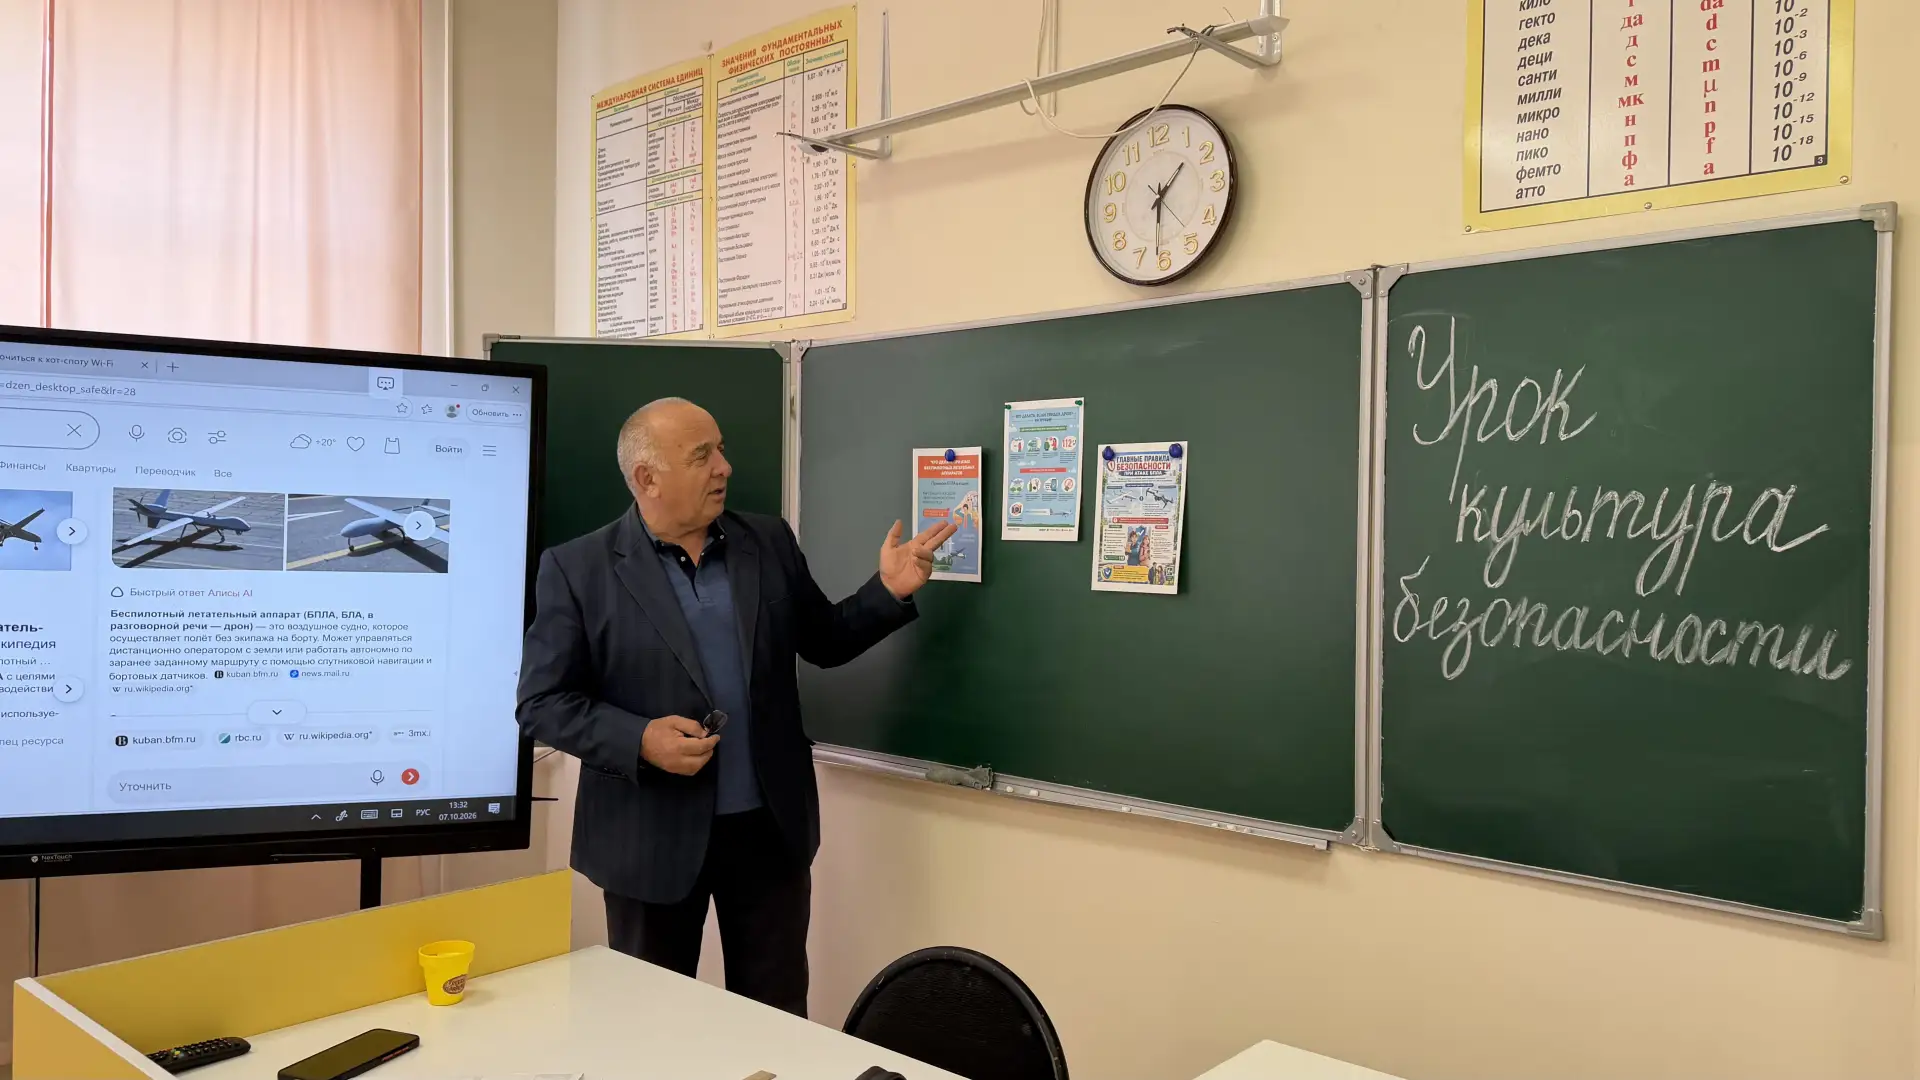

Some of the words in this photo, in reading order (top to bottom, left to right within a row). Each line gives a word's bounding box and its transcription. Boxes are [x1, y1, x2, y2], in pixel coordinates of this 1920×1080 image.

[1519, 12, 1555, 30] гекто
[1518, 32, 1551, 52] дека
[1620, 14, 1643, 31] да
[721, 48, 757, 68] ЗНАЧЕНИЯ
[761, 20, 843, 53] ФУНДАМЕНТАЛЬНЫХ
[1517, 51, 1553, 70] деци
[1626, 35, 1639, 50] д
[1706, 13, 1718, 31] d
[728, 53, 775, 75] ФИЗИЧЕСКИХ
[780, 33, 834, 58] ПОСТОЯННЫХ
[1517, 87, 1562, 105] милли
[1702, 58, 1720, 73] m
[1518, 69, 1557, 86] санти
[596, 86, 647, 110] МЕЖДУНАРОДНАЯ
[648, 77, 676, 92] СИСТЕМА
[676, 68, 703, 83] ЕДИНИЦ
[1517, 106, 1560, 124] микро
[1618, 93, 1644, 108] мк
[1516, 127, 1549, 143] нано
[1704, 100, 1716, 113] n
[1147, 123, 1170, 148] 12
[1182, 126, 1190, 148] 1
[1516, 146, 1548, 161] пико
[1704, 121, 1716, 138] p
[1122, 141, 1141, 166] 11
[1199, 141, 1215, 165] 2
[1516, 163, 1561, 183] фемто
[1622, 150, 1638, 170] ф
[1706, 137, 1716, 154] f
[1817, 156, 1824, 164] 3
[1105, 171, 1126, 195] 10
[1210, 170, 1225, 192] 3
[1515, 185, 1545, 199] атто
[1103, 203, 1117, 223] 9
[1202, 204, 1216, 226] 4
[1112, 230, 1127, 251] 8
[1183, 232, 1199, 255] 5
[1133, 246, 1147, 269] 7
[1157, 251, 1171, 271] 6
[46, 357, 89, 367] хот-споту
[91, 359, 114, 367] Wi-Fi
[472, 408, 509, 418] Обновить
[1408, 316, 1598, 505] Урок
[435, 444, 463, 454] Войти
[0, 461, 46, 471] Финансы
[66, 463, 116, 474] Квартиры
[135, 466, 196, 478] Переводчик
[1116, 462, 1171, 471] БЕЗОПАСНОСТИ
[214, 469, 232, 478] Все
[1456, 479, 1830, 598] культура
[130, 588, 176, 598] Быстрый
[178, 589, 205, 597] ответ
[208, 589, 240, 598] Алисы
[110, 609, 185, 618] Беспилотный
[187, 610, 257, 618] летательный
[259, 611, 301, 620] аппарат
[303, 610, 339, 620] (БПЛА,
[341, 610, 365, 620] БЛА,
[1393, 555, 1853, 680] безопасности
[110, 622, 180, 631] разговорной
[182, 623, 208, 632] речи
[223, 622, 254, 632] дрон)
[287, 623, 339, 631] воздушное
[340, 623, 370, 632] судно,
[372, 623, 409, 631] которое
[109, 635, 181, 643] осуществляет
[183, 633, 212, 642] полёт
[215, 633, 232, 642] без
[234, 635, 275, 643] экипажа
[291, 634, 320, 643] борту.
[322, 634, 352, 642] Может
[355, 635, 412, 643] управляться
[1, 640, 56, 650] кипедия
[109, 646, 182, 655] дистанционно
[183, 646, 243, 655] оператором
[253, 646, 283, 654] земли
[285, 646, 303, 654] или
[305, 646, 348, 655] работать
[109, 659, 151, 667] заранее
[154, 659, 208, 667] заданному
[211, 659, 259, 667] маршруту
[270, 658, 315, 666] помощью
[317, 657, 375, 666] спутниковой
[377, 657, 424, 665] навигации
[16, 673, 56, 681] целями
[109, 672, 158, 681] бортовых
[160, 672, 208, 680] датчиков.
[226, 670, 279, 678] kuban.bfm.ru
[301, 669, 350, 677] news.mail.ru
[1, 711, 60, 719] используе-
[22, 737, 64, 747] ресурса
[132, 734, 196, 744] kuban.bfm.ru
[235, 733, 262, 742] rbc.ru
[119, 781, 172, 792] Уточнить
[449, 801, 468, 809] 13:32
[416, 808, 431, 817] РУС
[438, 812, 477, 821] 07.10.2026
